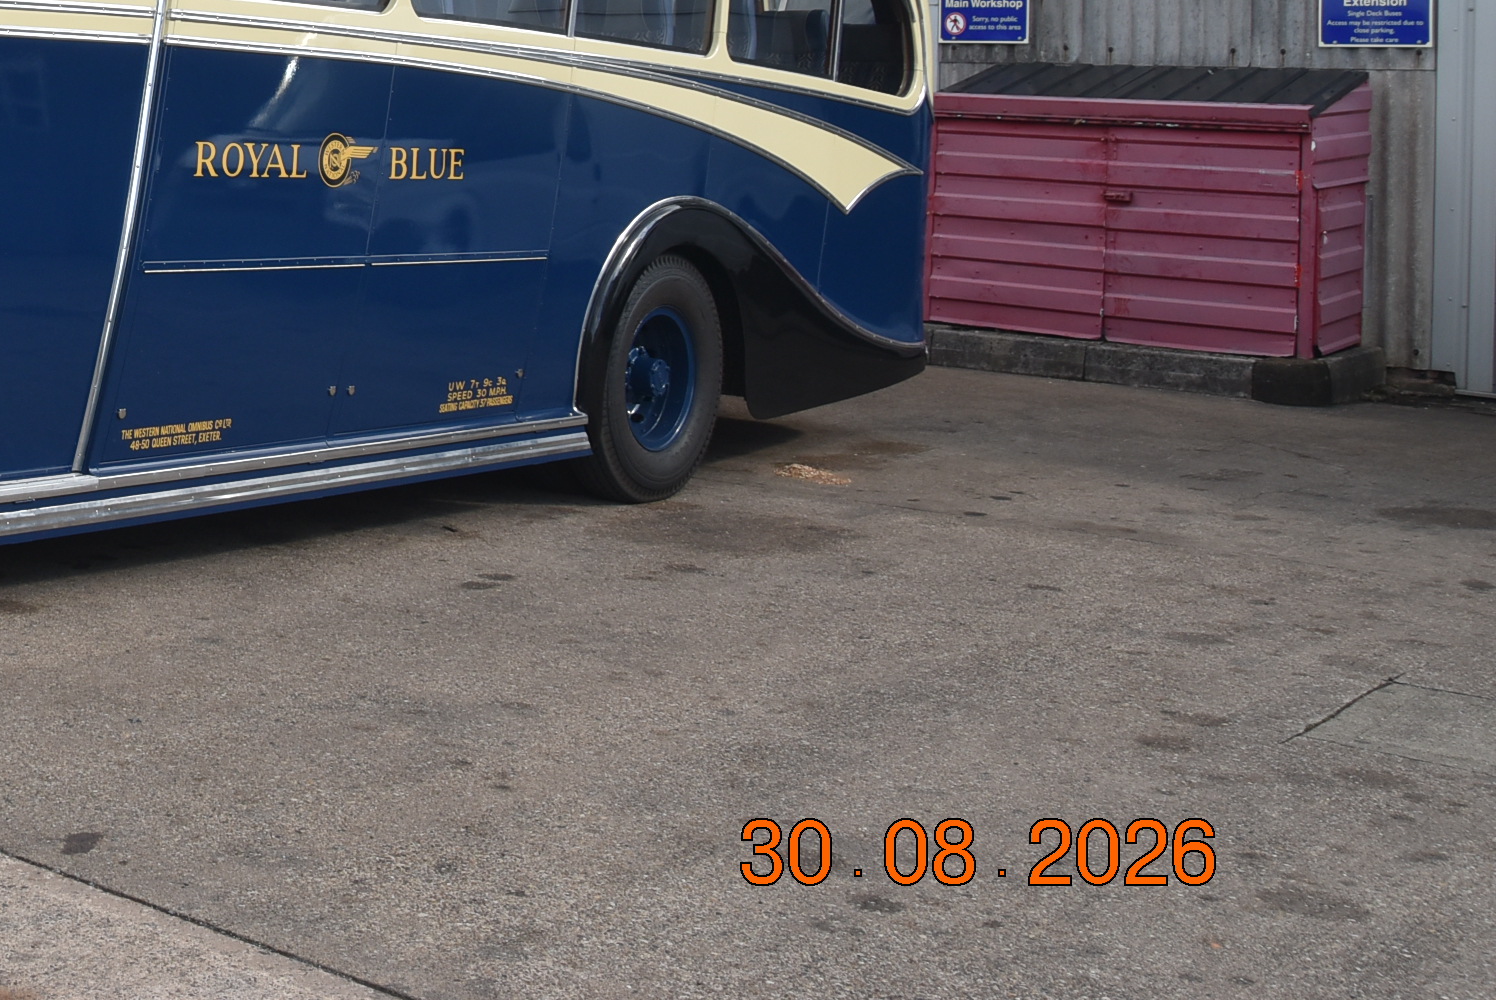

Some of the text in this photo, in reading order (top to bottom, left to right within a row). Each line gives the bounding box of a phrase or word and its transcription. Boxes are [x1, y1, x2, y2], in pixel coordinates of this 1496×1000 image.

[945, 0, 969, 8] Main
[1000, 15, 1018, 23] public
[1347, 10, 1365, 18] Single
[193, 141, 465, 180] ROYAL BLUE
[447, 390, 473, 402] SPEED
[476, 388, 487, 398] 30
[439, 402, 458, 413] SEATING
[458, 399, 479, 411] CAPACITY
[486, 395, 514, 407] PASSENGERS
[121, 429, 133, 440] THE
[133, 426, 161, 439] WESTERN
[160, 423, 186, 435] NATIONAL
[188, 420, 213, 432] OMNIBUS
[151, 436, 172, 449] QUEEN
[172, 433, 197, 446] STREET,
